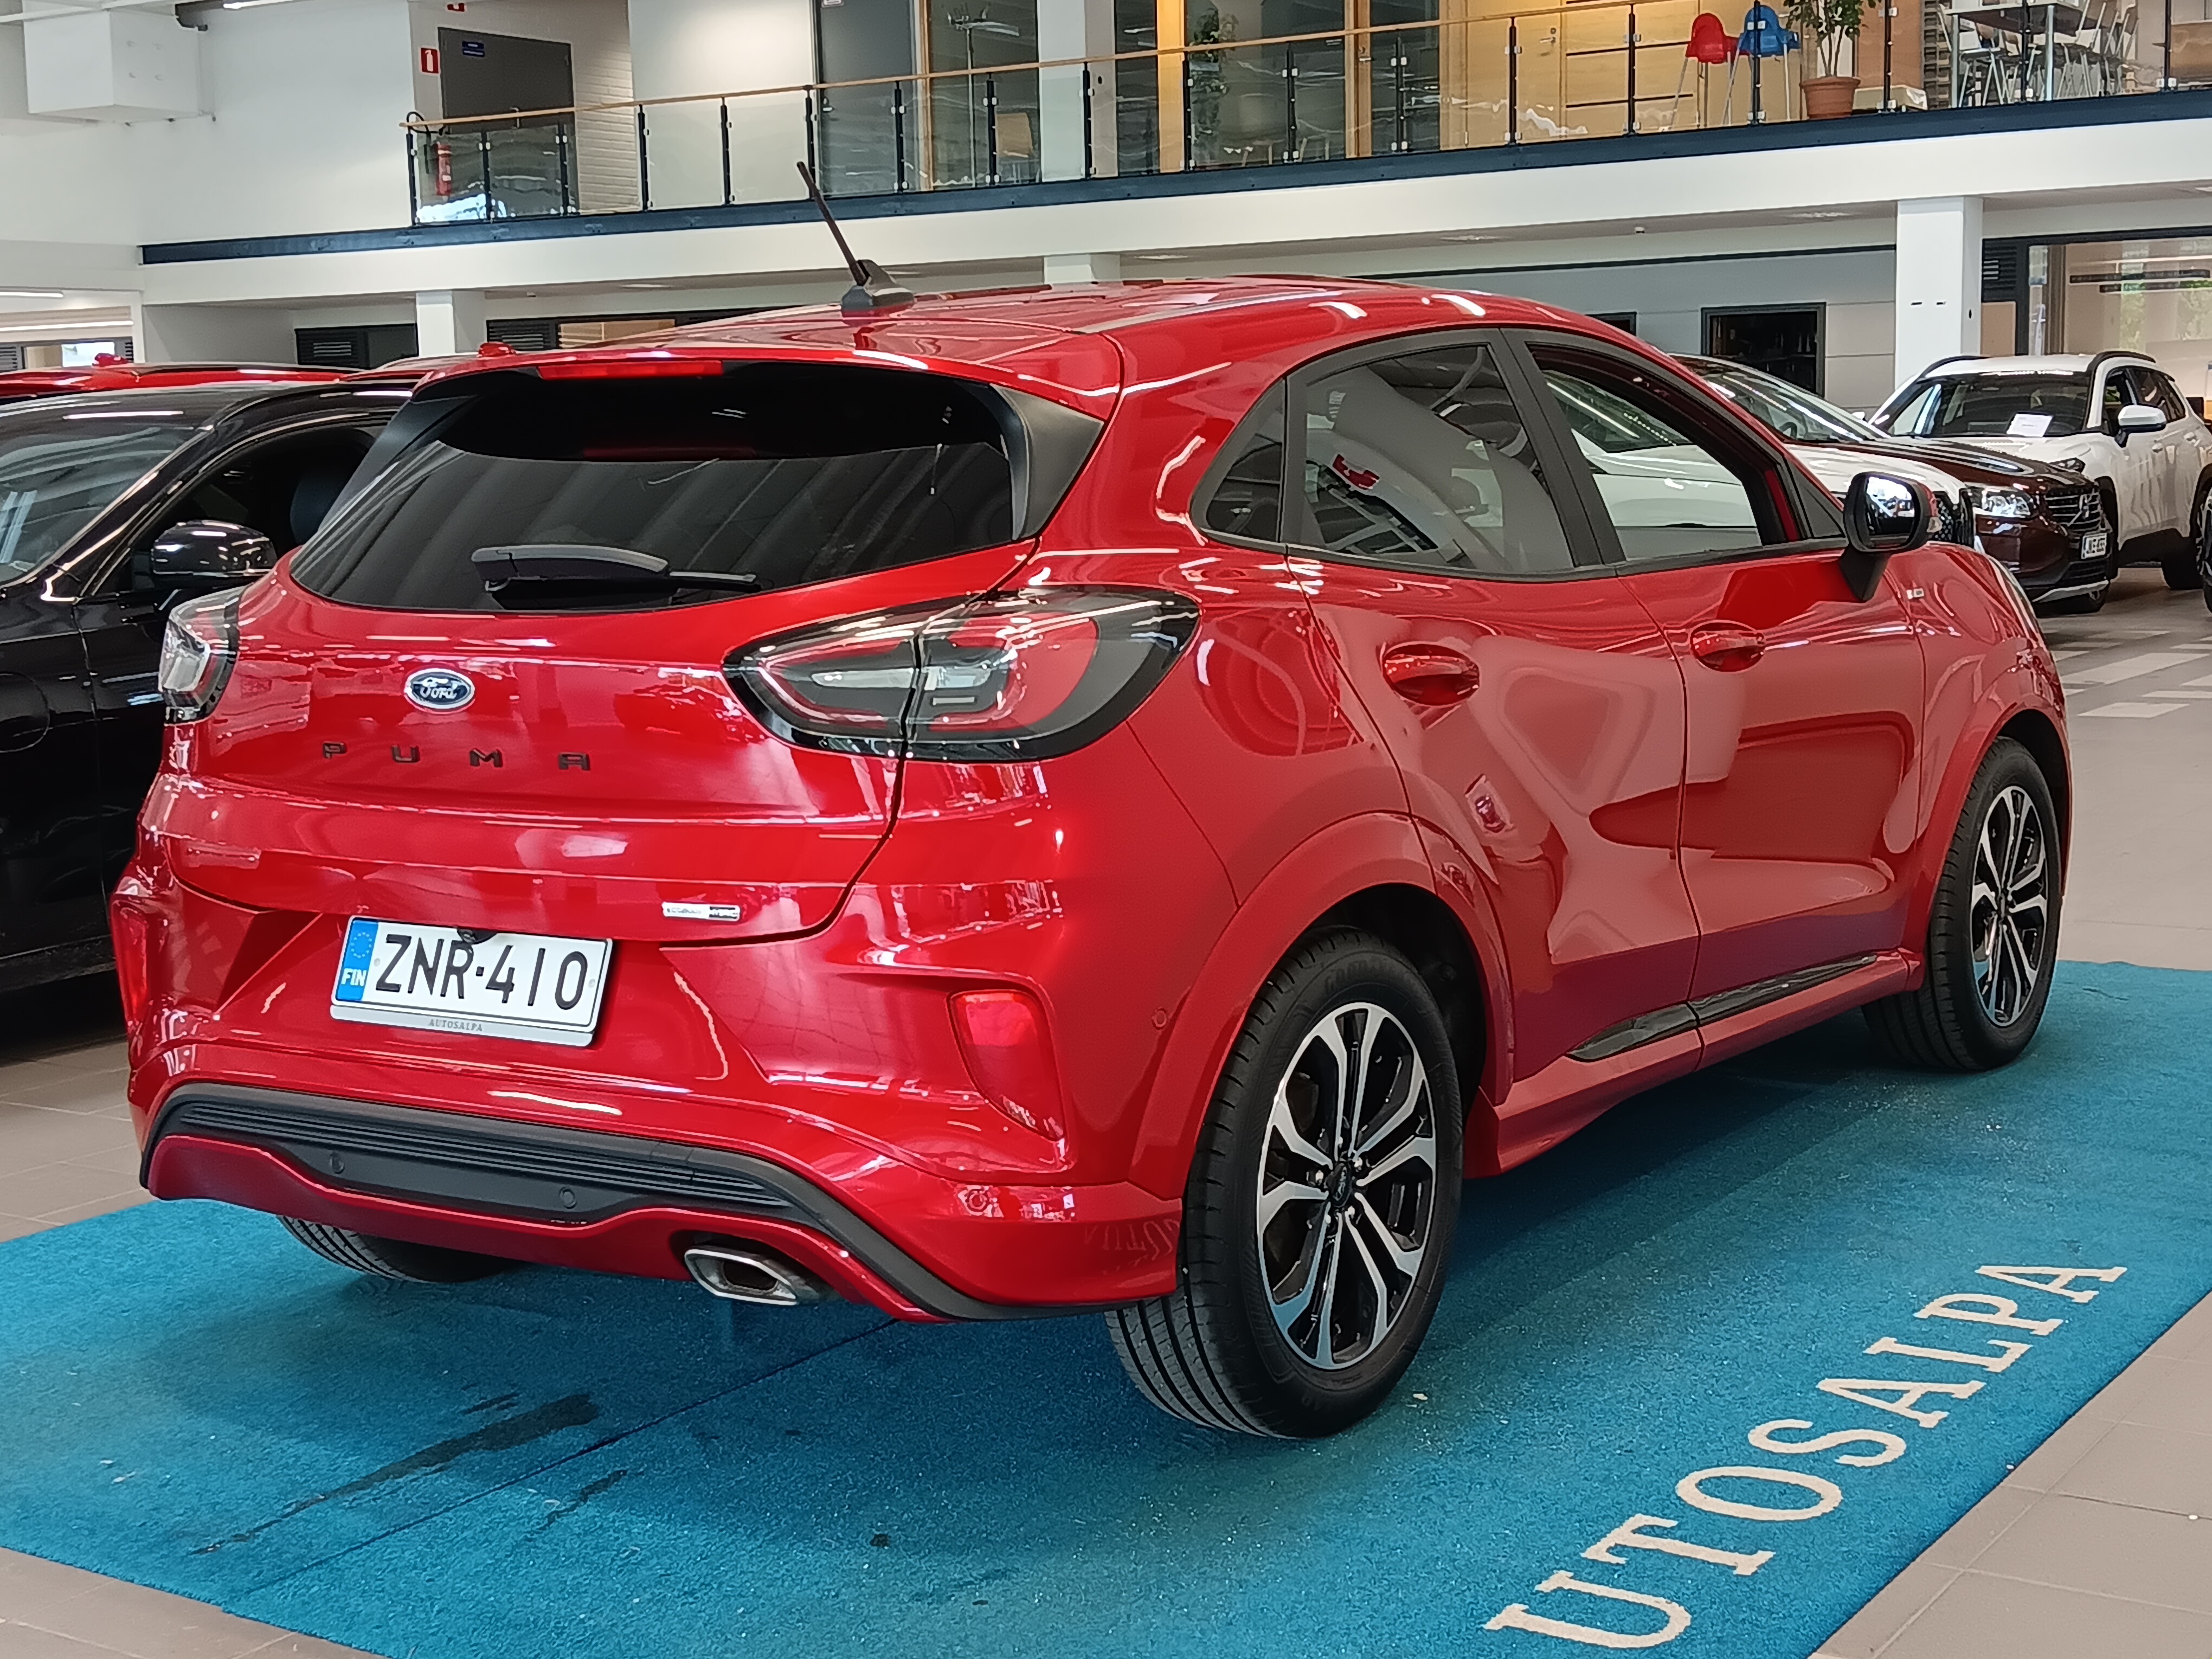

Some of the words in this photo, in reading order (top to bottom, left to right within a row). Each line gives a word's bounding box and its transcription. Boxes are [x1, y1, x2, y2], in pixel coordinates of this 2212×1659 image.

[413, 677, 461, 699] Ford
[323, 741, 590, 771] PUMA
[341, 968, 367, 987] FIN
[428, 1019, 483, 1032] AUTOSALPA
